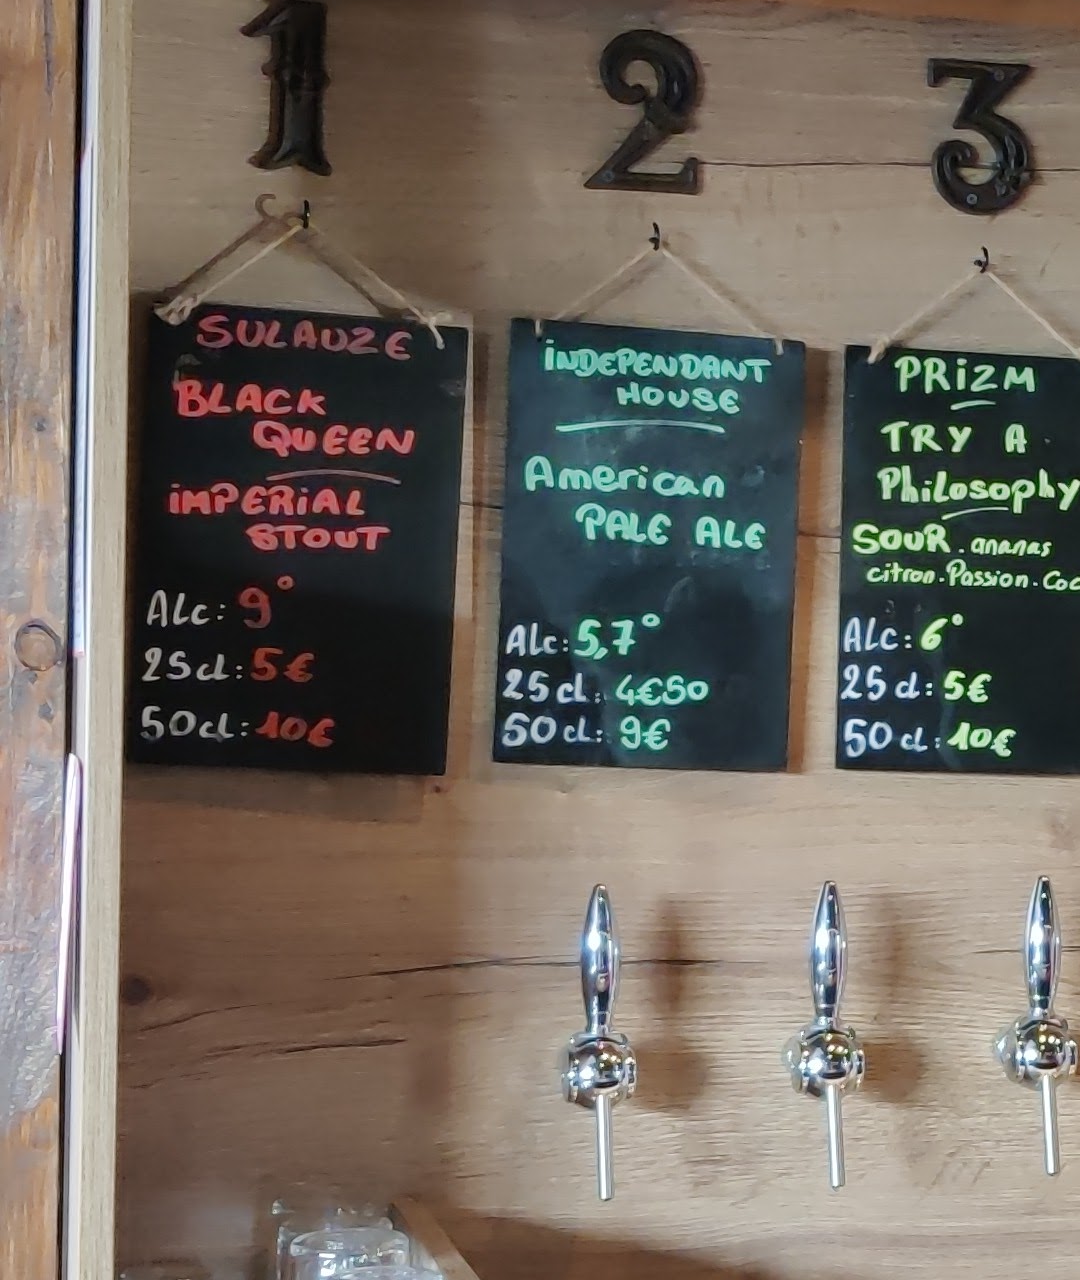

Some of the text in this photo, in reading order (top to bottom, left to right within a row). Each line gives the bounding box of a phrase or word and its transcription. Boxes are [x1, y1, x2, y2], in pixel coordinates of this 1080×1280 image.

[586, 28, 705, 196] 2
[926, 56, 1033, 216] 3
[197, 314, 412, 359] SULAUZE
[175, 380, 326, 415] BLACK
[616, 386, 740, 414] HOUSE
[253, 425, 414, 456] QUEEN
[881, 421, 1026, 453] TRY A
[525, 455, 725, 498] American
[877, 466, 1080, 514] Philosophy
[246, 525, 391, 550] STOUT
[575, 503, 765, 549] PALE ALE
[971, 536, 1052, 557] ananas
[919, 614, 963, 649] 6°
[251, 648, 314, 682] 5€
[615, 675, 709, 705] 4€50
[942, 674, 992, 703] 5€
[256, 709, 335, 747] 10€
[619, 718, 671, 750] 9€
[948, 721, 1015, 757] 10€
